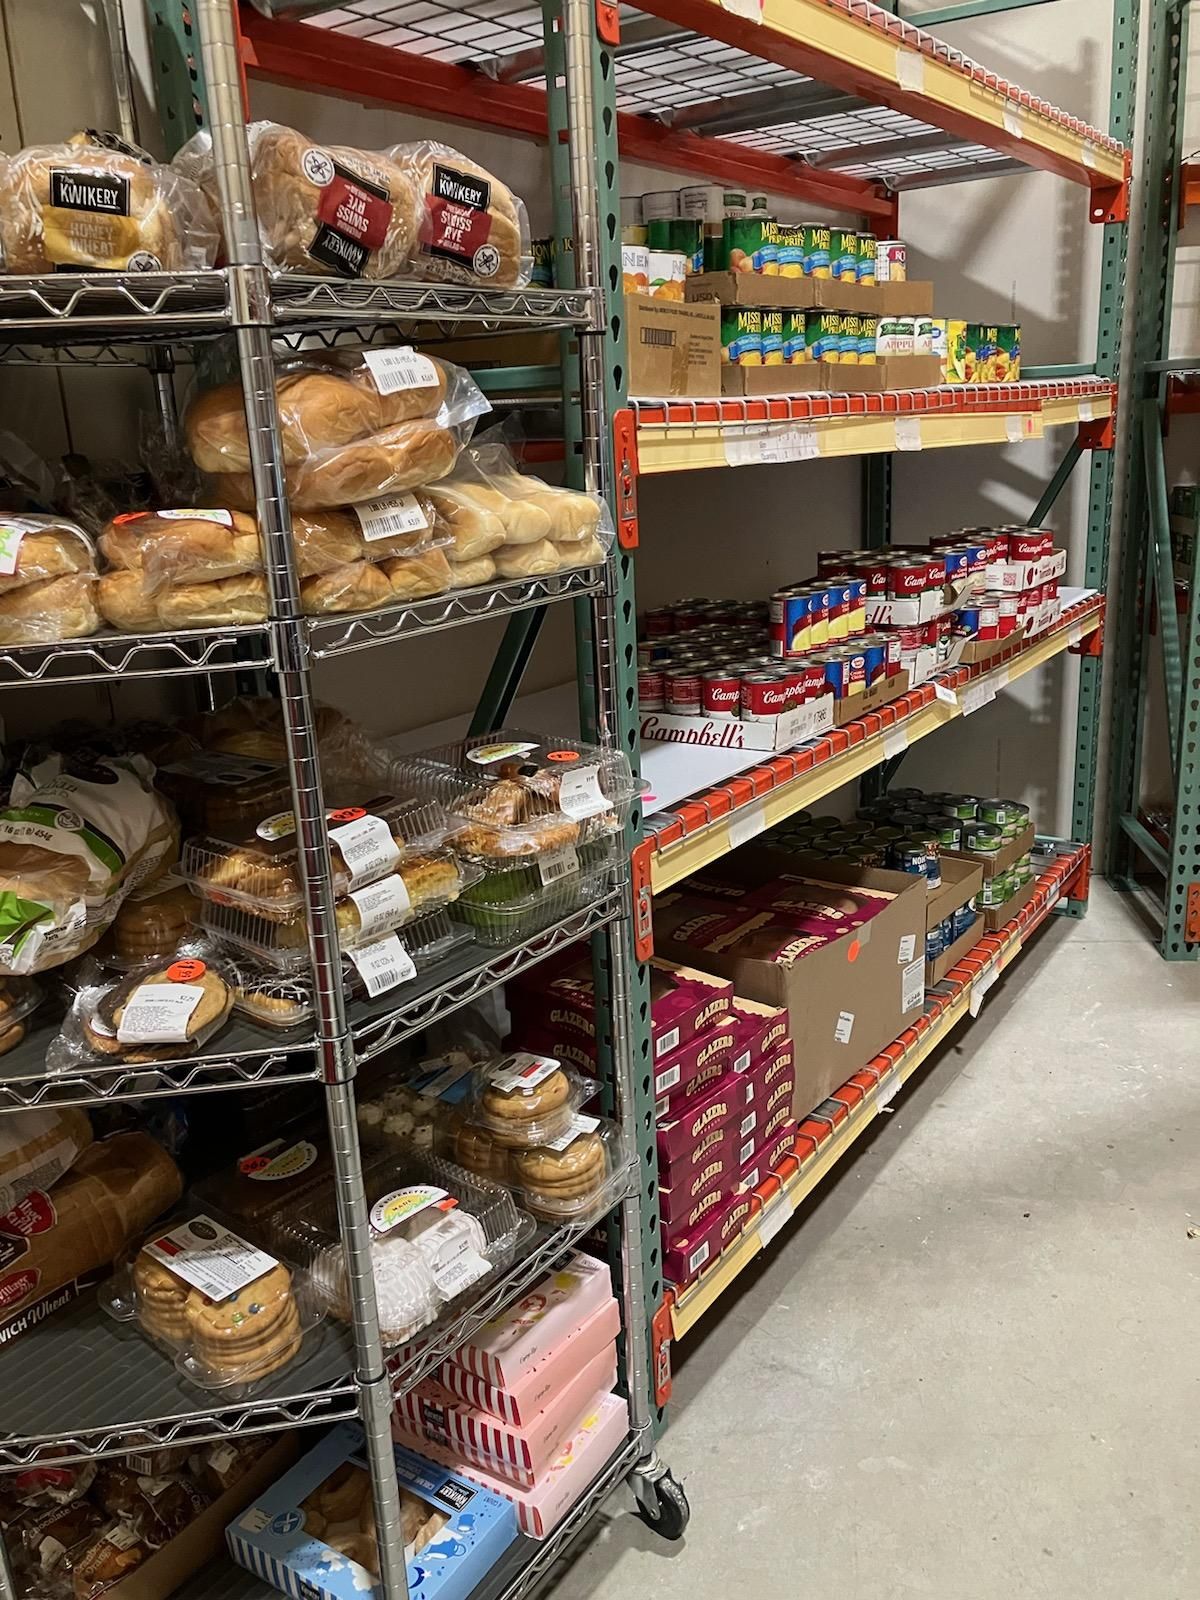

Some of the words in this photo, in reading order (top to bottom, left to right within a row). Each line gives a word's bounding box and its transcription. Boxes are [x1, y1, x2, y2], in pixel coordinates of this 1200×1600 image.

[59, 185, 119, 207] KWIKERY
[346, 193, 366, 216] RYE
[439, 179, 482, 203] KWIKERY
[70, 222, 113, 240] HONEY
[336, 204, 370, 233] SWISS
[440, 211, 472, 232] SWISS
[70, 239, 116, 257] WHEAT
[322, 233, 365, 263] KWIKERY
[444, 226, 464, 243] RYE
[712, 688, 739, 702] Camp
[640, 716, 744, 748] Campbell's
[550, 1009, 595, 1038] GLAZERS
[695, 998, 730, 1030] GLAZERS
[697, 1035, 734, 1067] GLAZERS
[761, 1023, 787, 1053] GLAZERS
[553, 1044, 597, 1074] GLAZERS
[764, 1053, 791, 1084] GLAZERS
[686, 1064, 723, 1097] GLAZERS
[767, 1080, 793, 1112] GLAZERS
[692, 1103, 728, 1137] GLAZERS
[765, 1106, 790, 1138] GLAZERS
[692, 1129, 724, 1164] GLAZERS
[769, 1134, 795, 1167] GLAZERS
[691, 1160, 723, 1196] GLAZERS
[688, 1190, 722, 1226] GLAZERS
[721, 1202, 749, 1239] GLAZERS
[27, 1292, 72, 1326] Wheat
